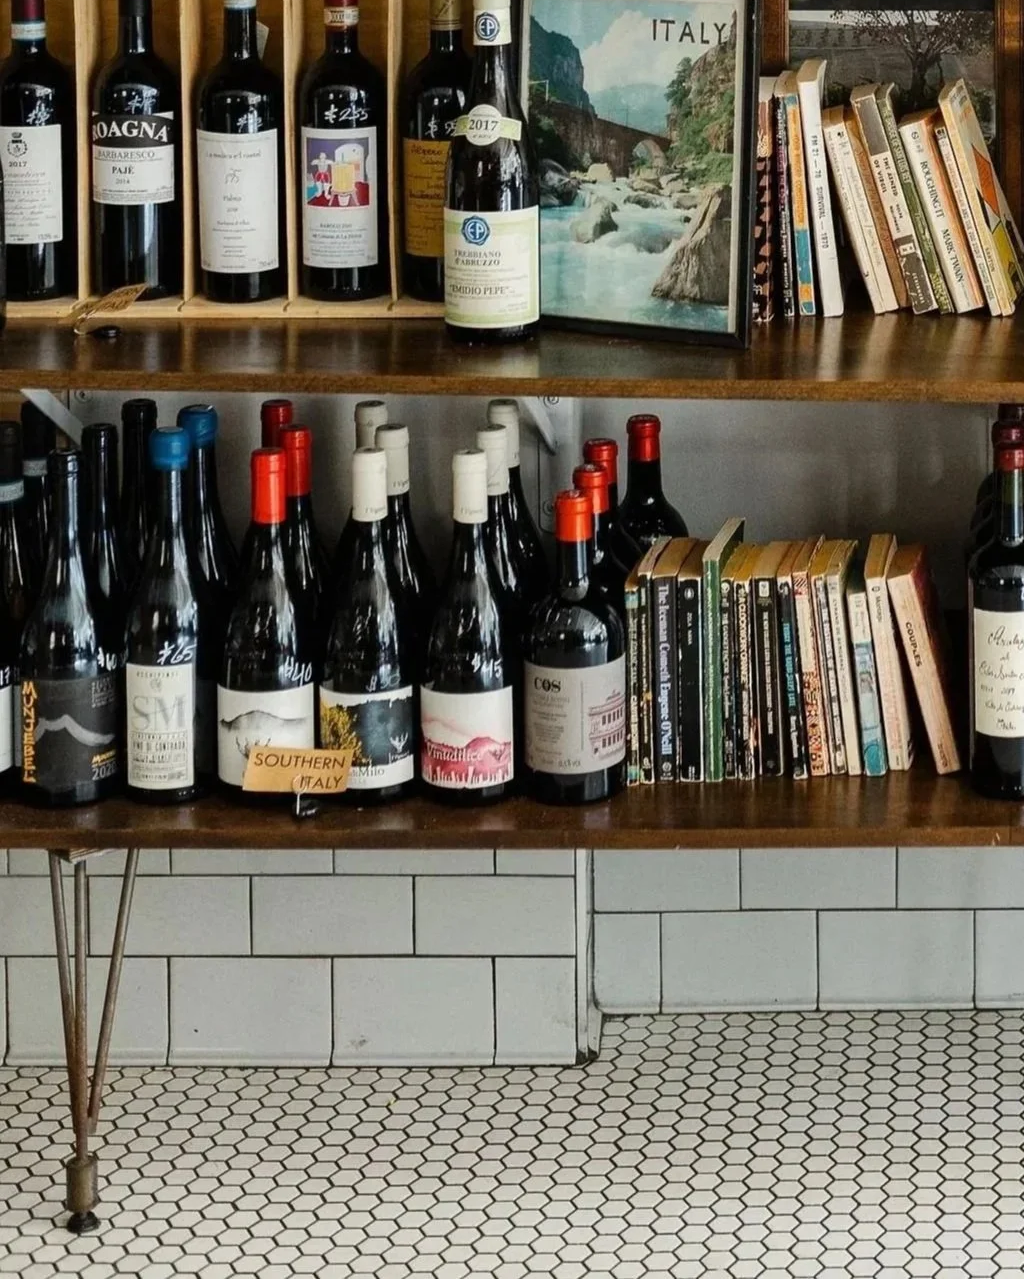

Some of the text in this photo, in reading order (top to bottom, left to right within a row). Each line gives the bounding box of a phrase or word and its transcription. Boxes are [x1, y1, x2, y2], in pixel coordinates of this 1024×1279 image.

[652, 19, 726, 44] ITALY
[468, 118, 498, 132] 2017
[919, 160, 945, 219] ROUGHING IT
[815, 187, 826, 219] SURVIVAL
[454, 249, 501, 258] TREBBIANO
[940, 228, 966, 283] MARK TWAIN
[658, 585, 670, 681] The Iceman Cometh
[905, 621, 922, 668] COUPLES
[157, 641, 197, 665] $65
[534, 676, 562, 693] COS
[658, 683, 672, 755] Eugene O'Neill
[254, 753, 346, 770] SOUTHERN
[300, 776, 342, 790] ITALY
